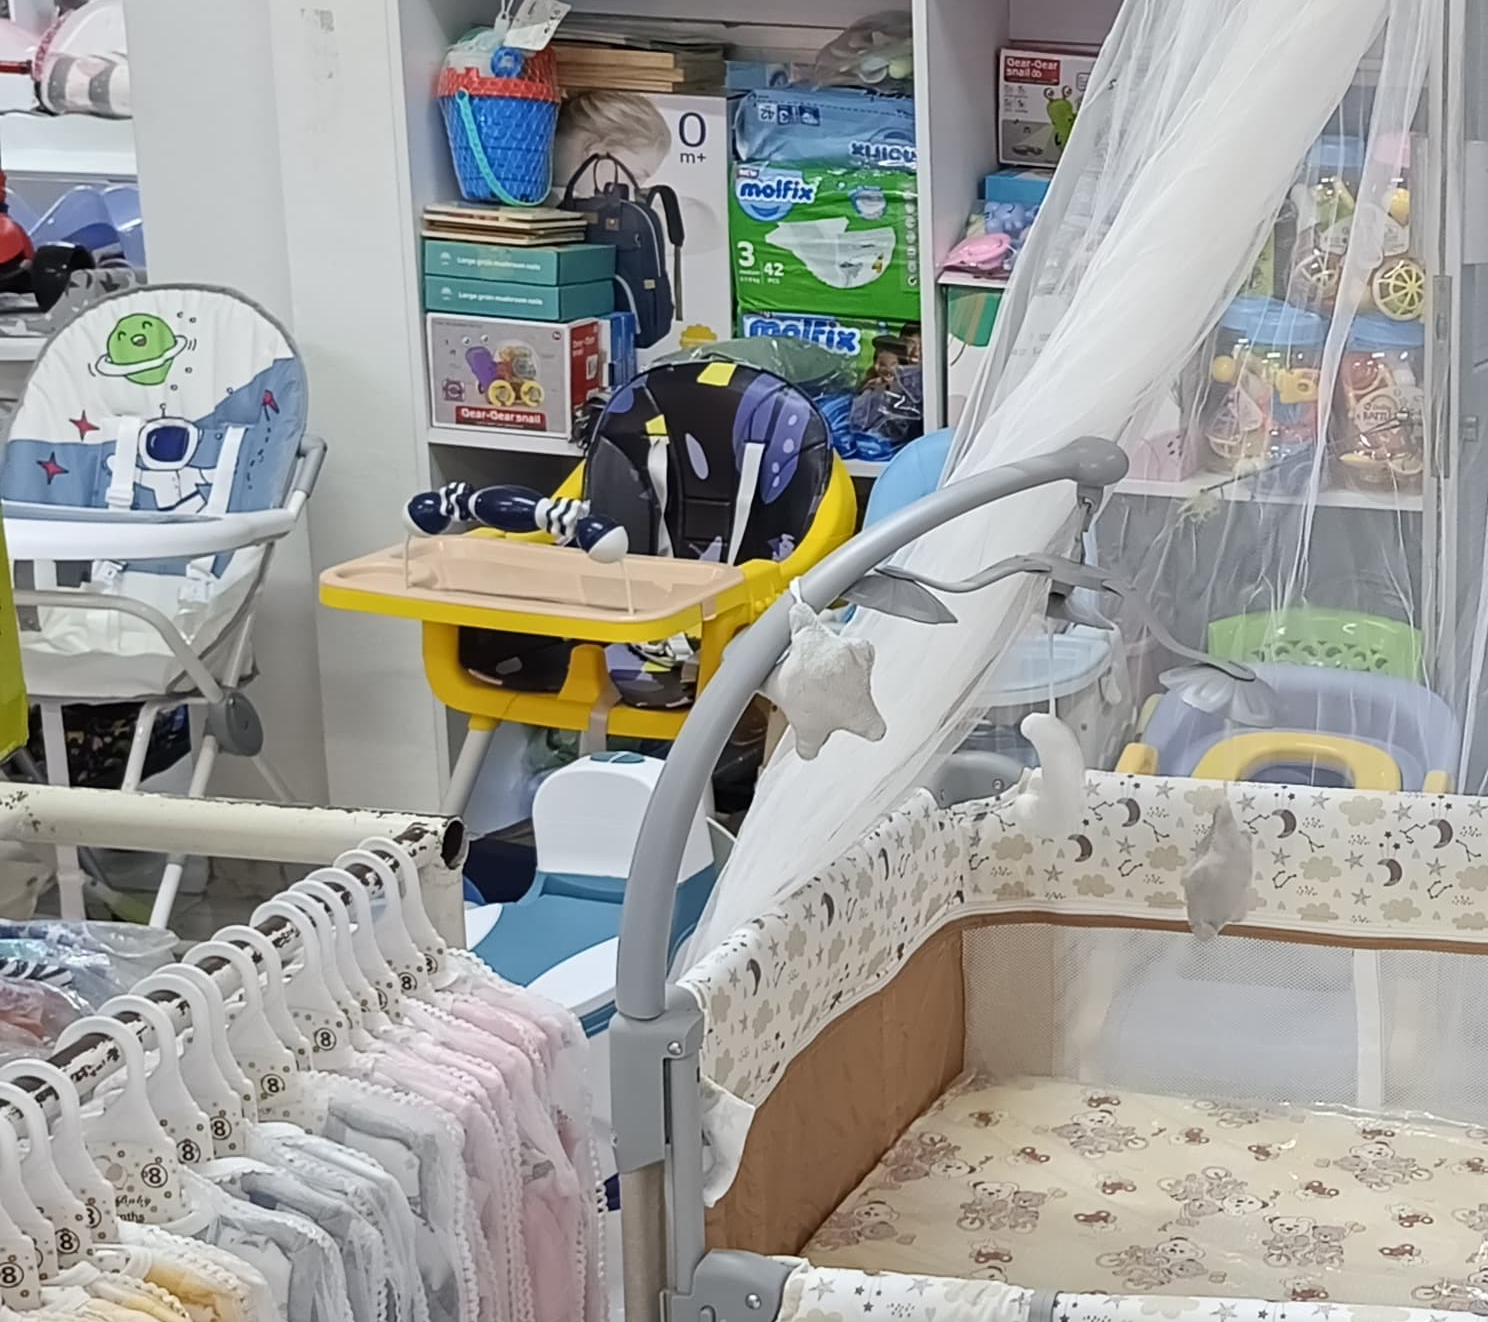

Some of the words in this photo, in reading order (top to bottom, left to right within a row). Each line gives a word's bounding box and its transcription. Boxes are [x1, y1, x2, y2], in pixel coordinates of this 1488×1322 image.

[1006, 58, 1058, 69] Gear-Gear
[1006, 68, 1030, 76] snail
[760, 108, 775, 120] 42
[779, 110, 789, 123] 3
[679, 112, 706, 148] 0
[680, 153, 706, 164] m+
[739, 168, 757, 177] NEW
[740, 180, 814, 202] molfix
[738, 242, 755, 266] 3
[764, 262, 784, 276] 42
[459, 292, 477, 300] Large
[461, 408, 515, 422] Gear-Gear
[515, 412, 541, 424] snail
[402, 976, 412, 990] 8
[320, 1032, 331, 1047] 8
[267, 1077, 279, 1093] 8
[214, 1120, 226, 1136] 8
[182, 1144, 194, 1161] 8
[150, 1167, 162, 1184] 8
[60, 1233, 74, 1250] 8
[2, 1266, 17, 1284] 8
